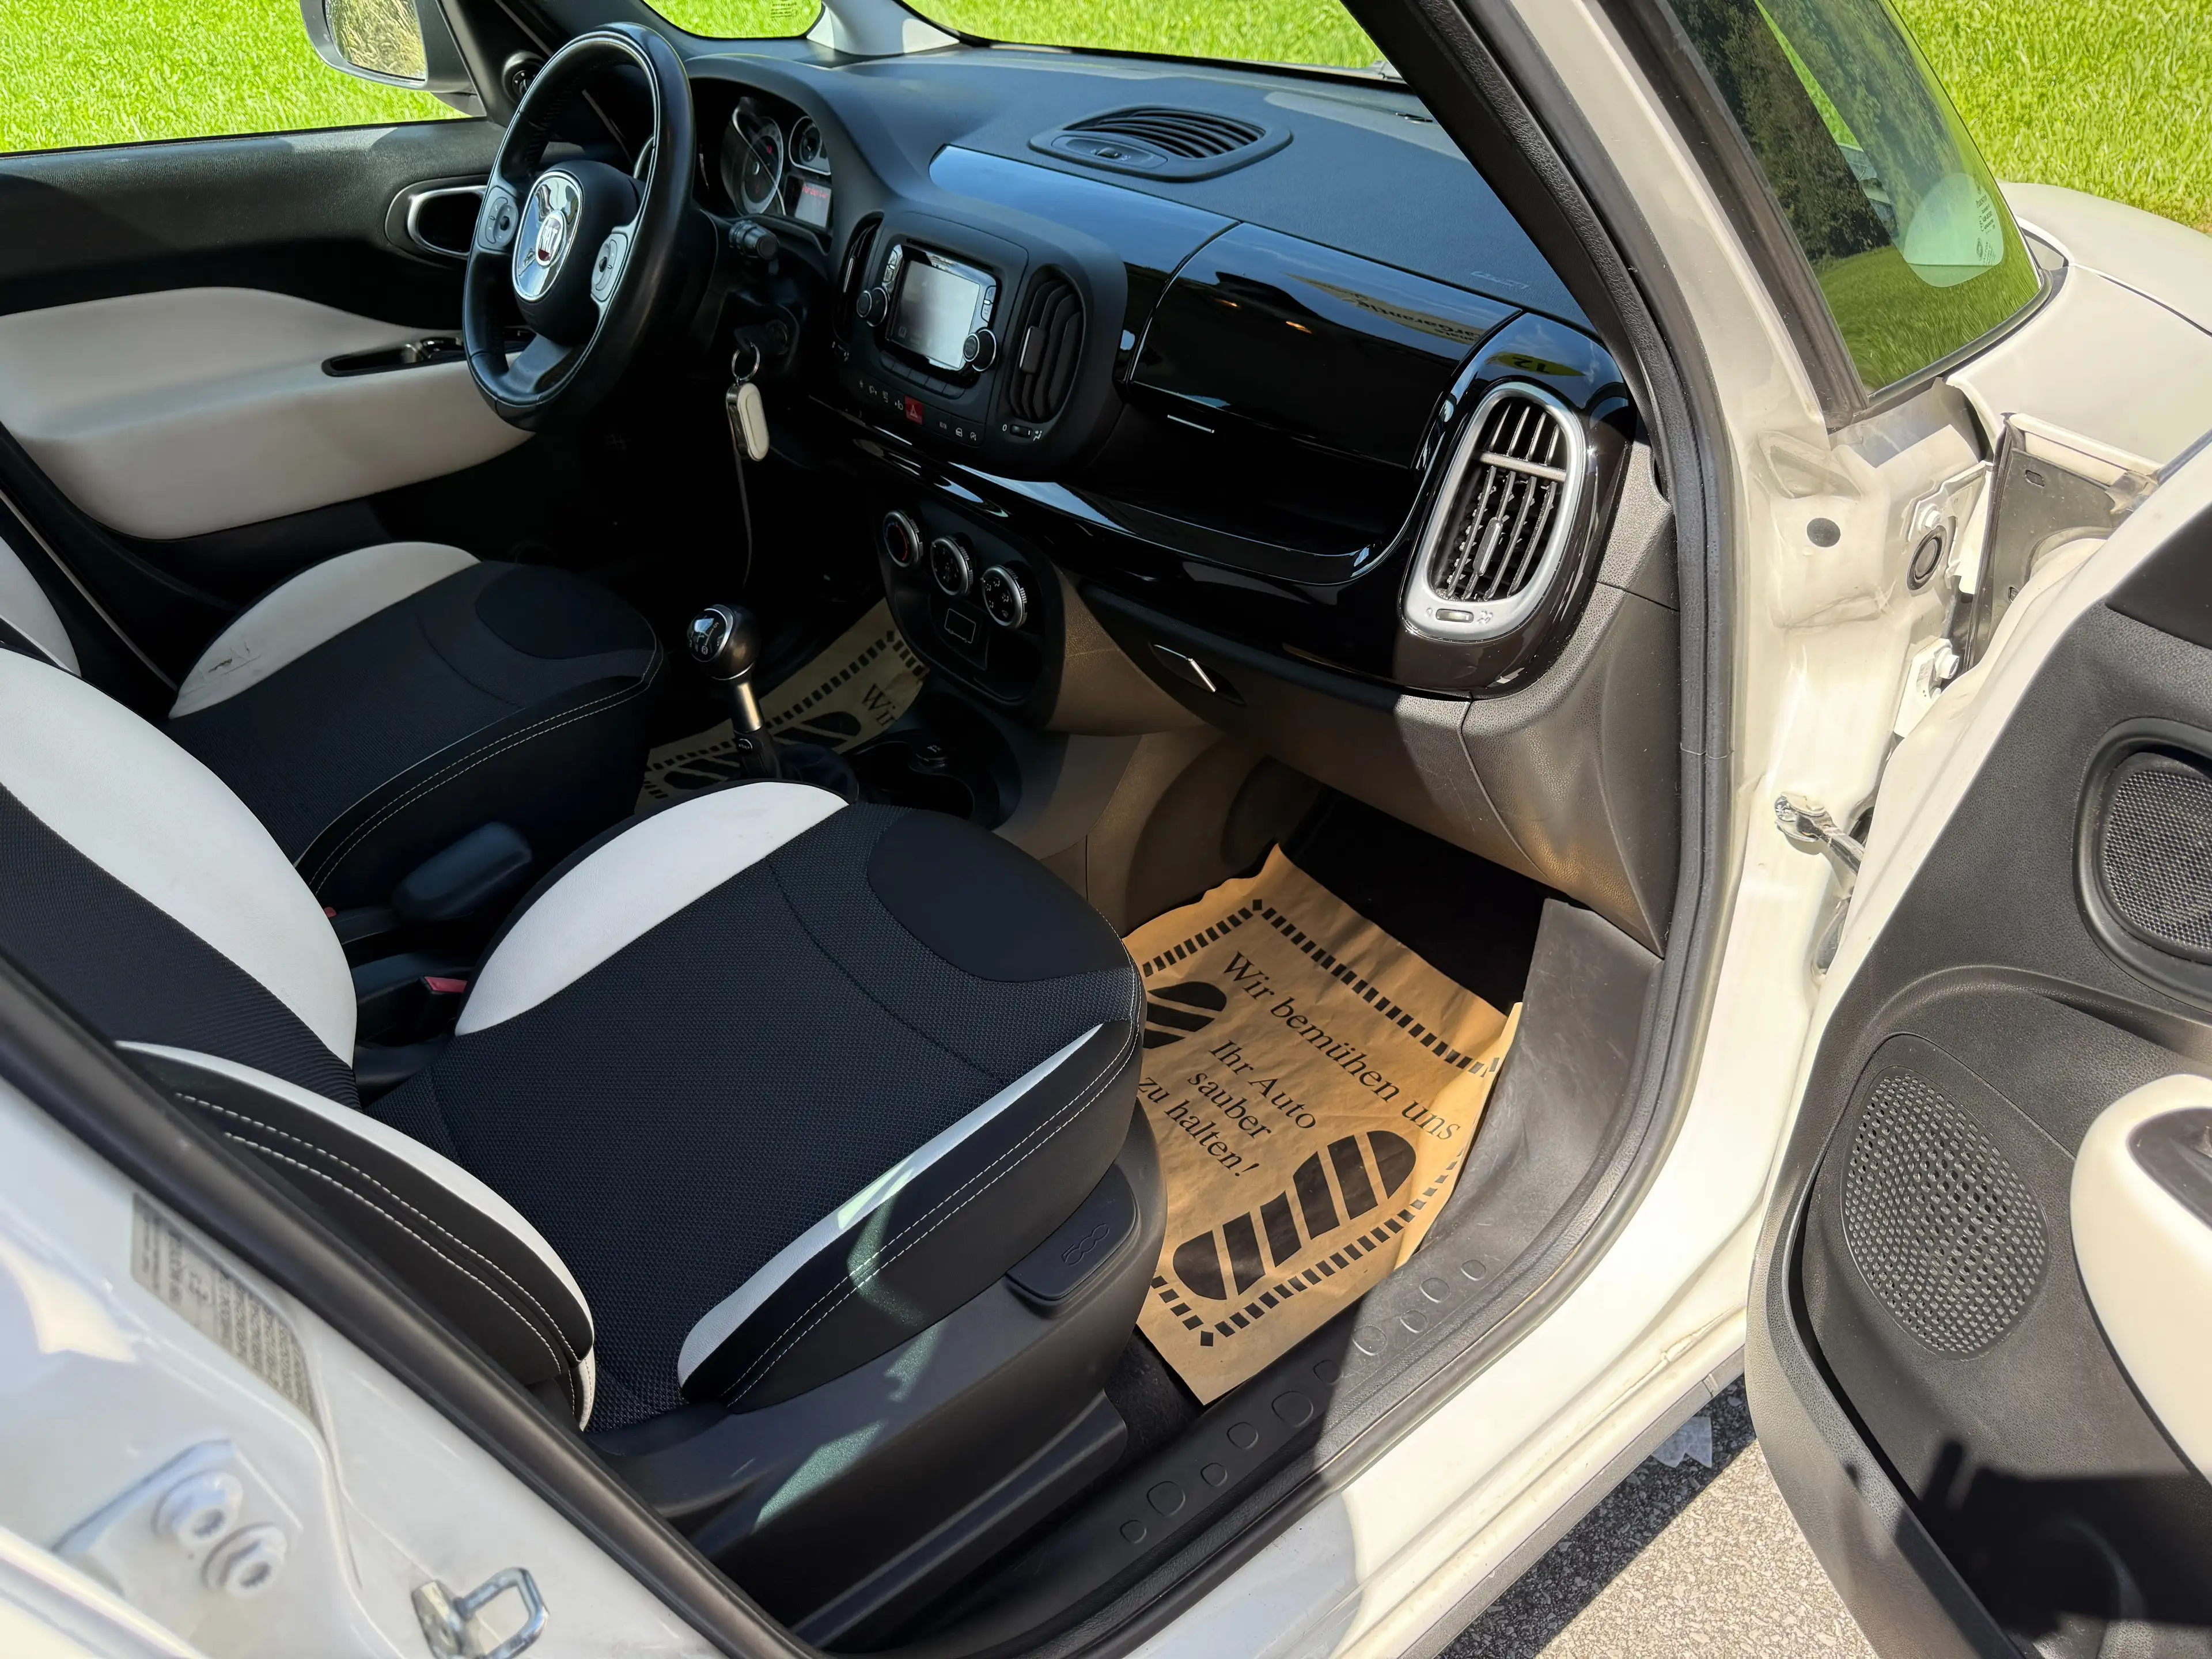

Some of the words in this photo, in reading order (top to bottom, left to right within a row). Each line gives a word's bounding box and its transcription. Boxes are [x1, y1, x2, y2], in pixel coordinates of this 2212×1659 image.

[861, 683, 897, 726] Wir
[1209, 1039, 1254, 1075] Ihr
[1247, 1078, 1316, 1128] Auto
[1223, 951, 1275, 1001] Wir
[1270, 996, 1400, 1103] bemühen
[1402, 1100, 1461, 1140] uns
[1138, 1077, 1171, 1104] zu
[1164, 1099, 1260, 1177] halten!
[1187, 1073, 1272, 1139] sauber
